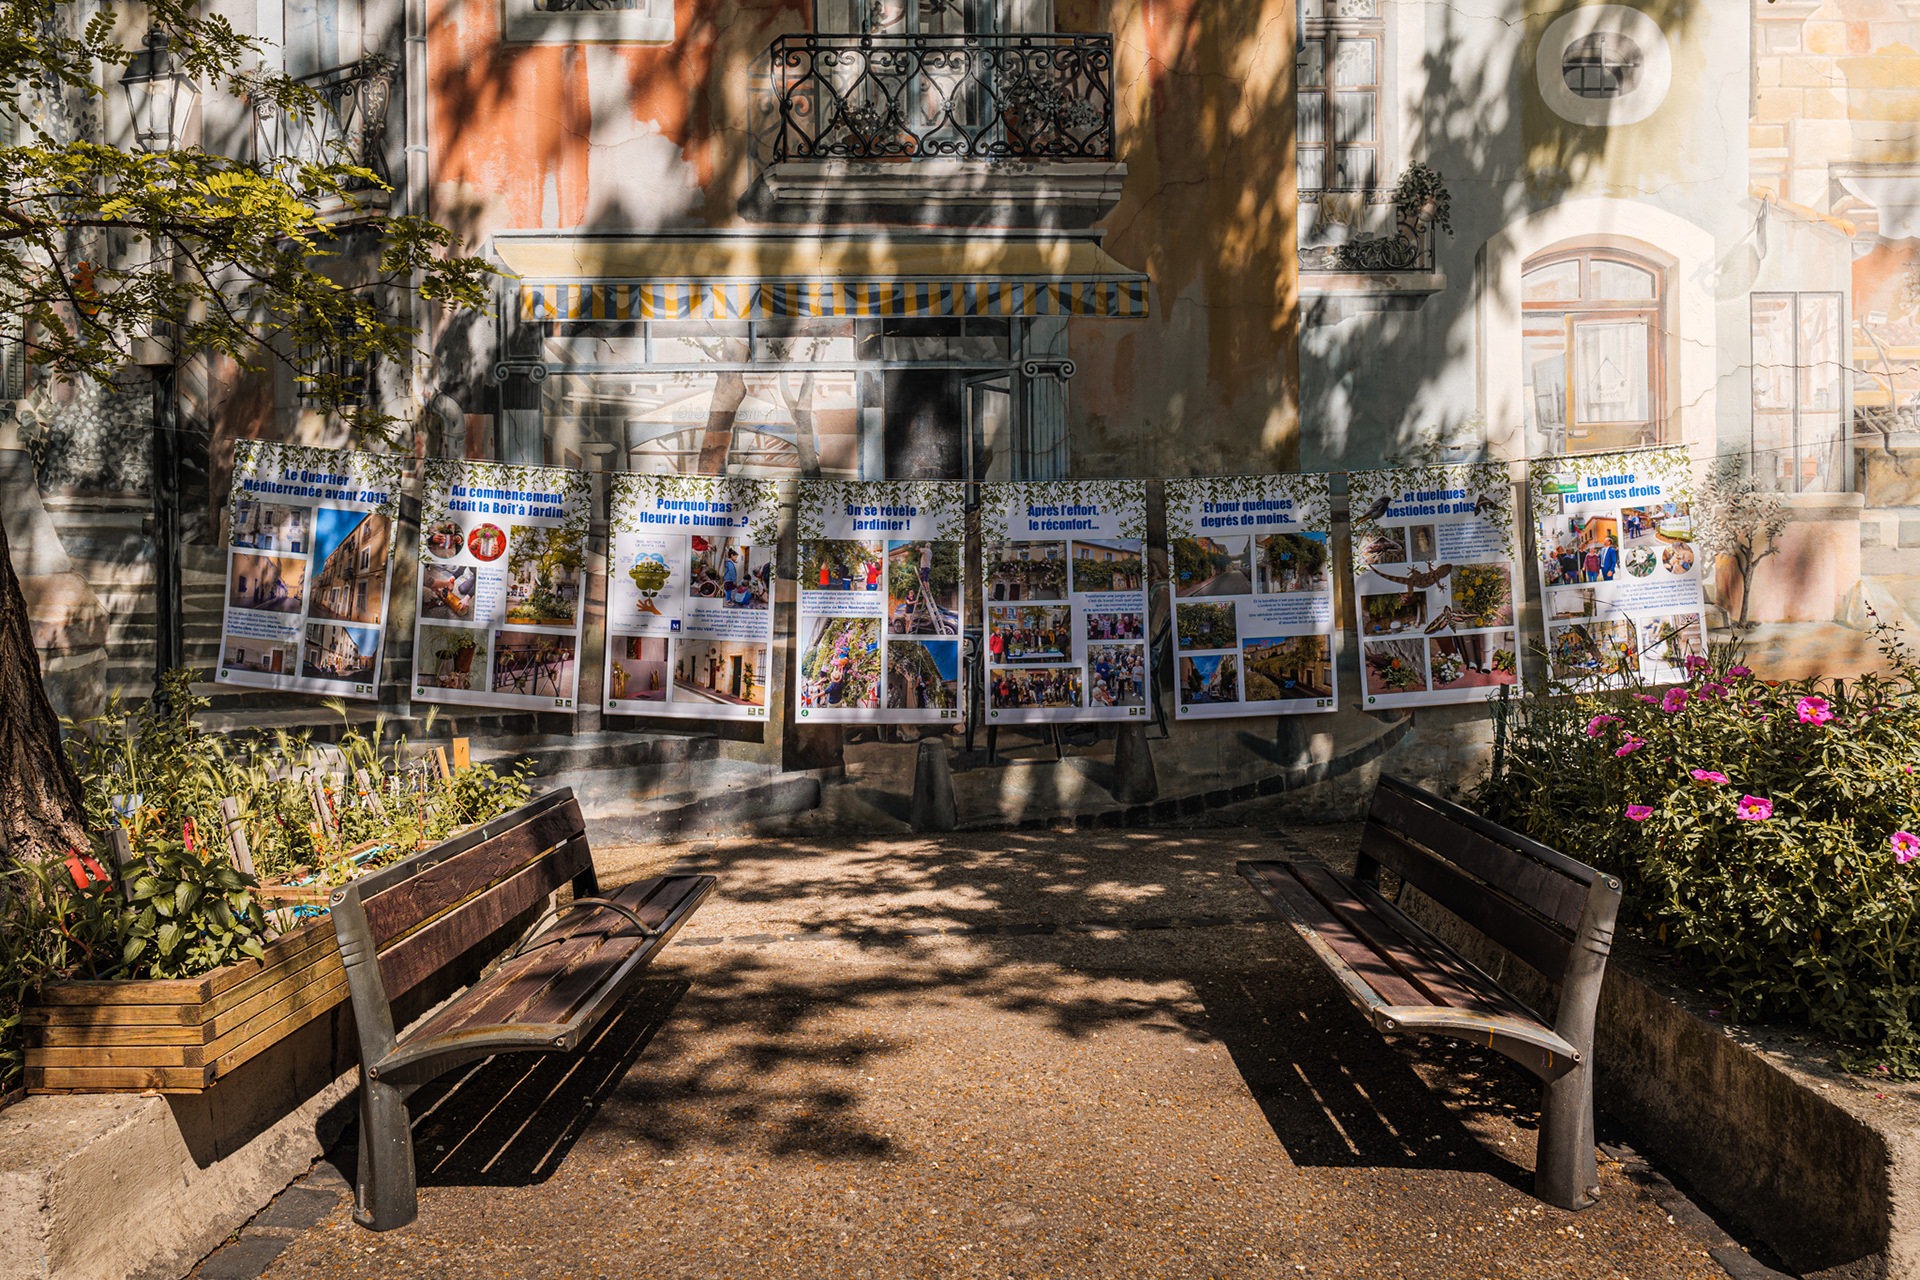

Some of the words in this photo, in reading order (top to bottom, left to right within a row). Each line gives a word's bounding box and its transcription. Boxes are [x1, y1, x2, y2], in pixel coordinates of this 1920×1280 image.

[285, 469, 298, 480] Le
[301, 470, 349, 486] Quartier
[1587, 477, 1598, 487] La
[1601, 474, 1635, 486] nature
[244, 479, 322, 498] Méditerranée
[325, 488, 357, 501] avant
[360, 491, 388, 504] 2015
[452, 485, 466, 496] Au
[469, 488, 562, 504] commencement
[1404, 492, 1414, 502] et
[1417, 489, 1465, 502] quelques
[1565, 490, 1606, 504] reprend
[1608, 489, 1626, 499] ses
[1629, 485, 1660, 498] droits
[449, 499, 476, 511] était
[479, 501, 489, 512] la
[493, 502, 525, 515] Boît'à
[528, 505, 563, 518] Jardin
[657, 498, 708, 512] Pourquoi
[712, 502, 732, 513] pas
[847, 504, 861, 515] On
[864, 506, 877, 516] se
[881, 504, 916, 516] révèle
[1028, 505, 1059, 517] Après
[1061, 504, 1099, 516] l'effort,
[1204, 502, 1213, 512] Et
[1216, 502, 1240, 513] pour
[1242, 499, 1292, 512] quelques
[1386, 504, 1435, 517] bestioles
[1438, 503, 1450, 514] de
[1453, 502, 1475, 514] plus
[640, 512, 676, 524] fleurir
[680, 514, 690, 525] le
[853, 519, 903, 531] jardinier
[906, 520, 910, 530] !
[1029, 520, 1039, 530] le
[1041, 519, 1099, 530] réconfort...
[1201, 514, 1239, 528] degrés
[1241, 514, 1254, 525] de
[1256, 513, 1296, 524] moins...
